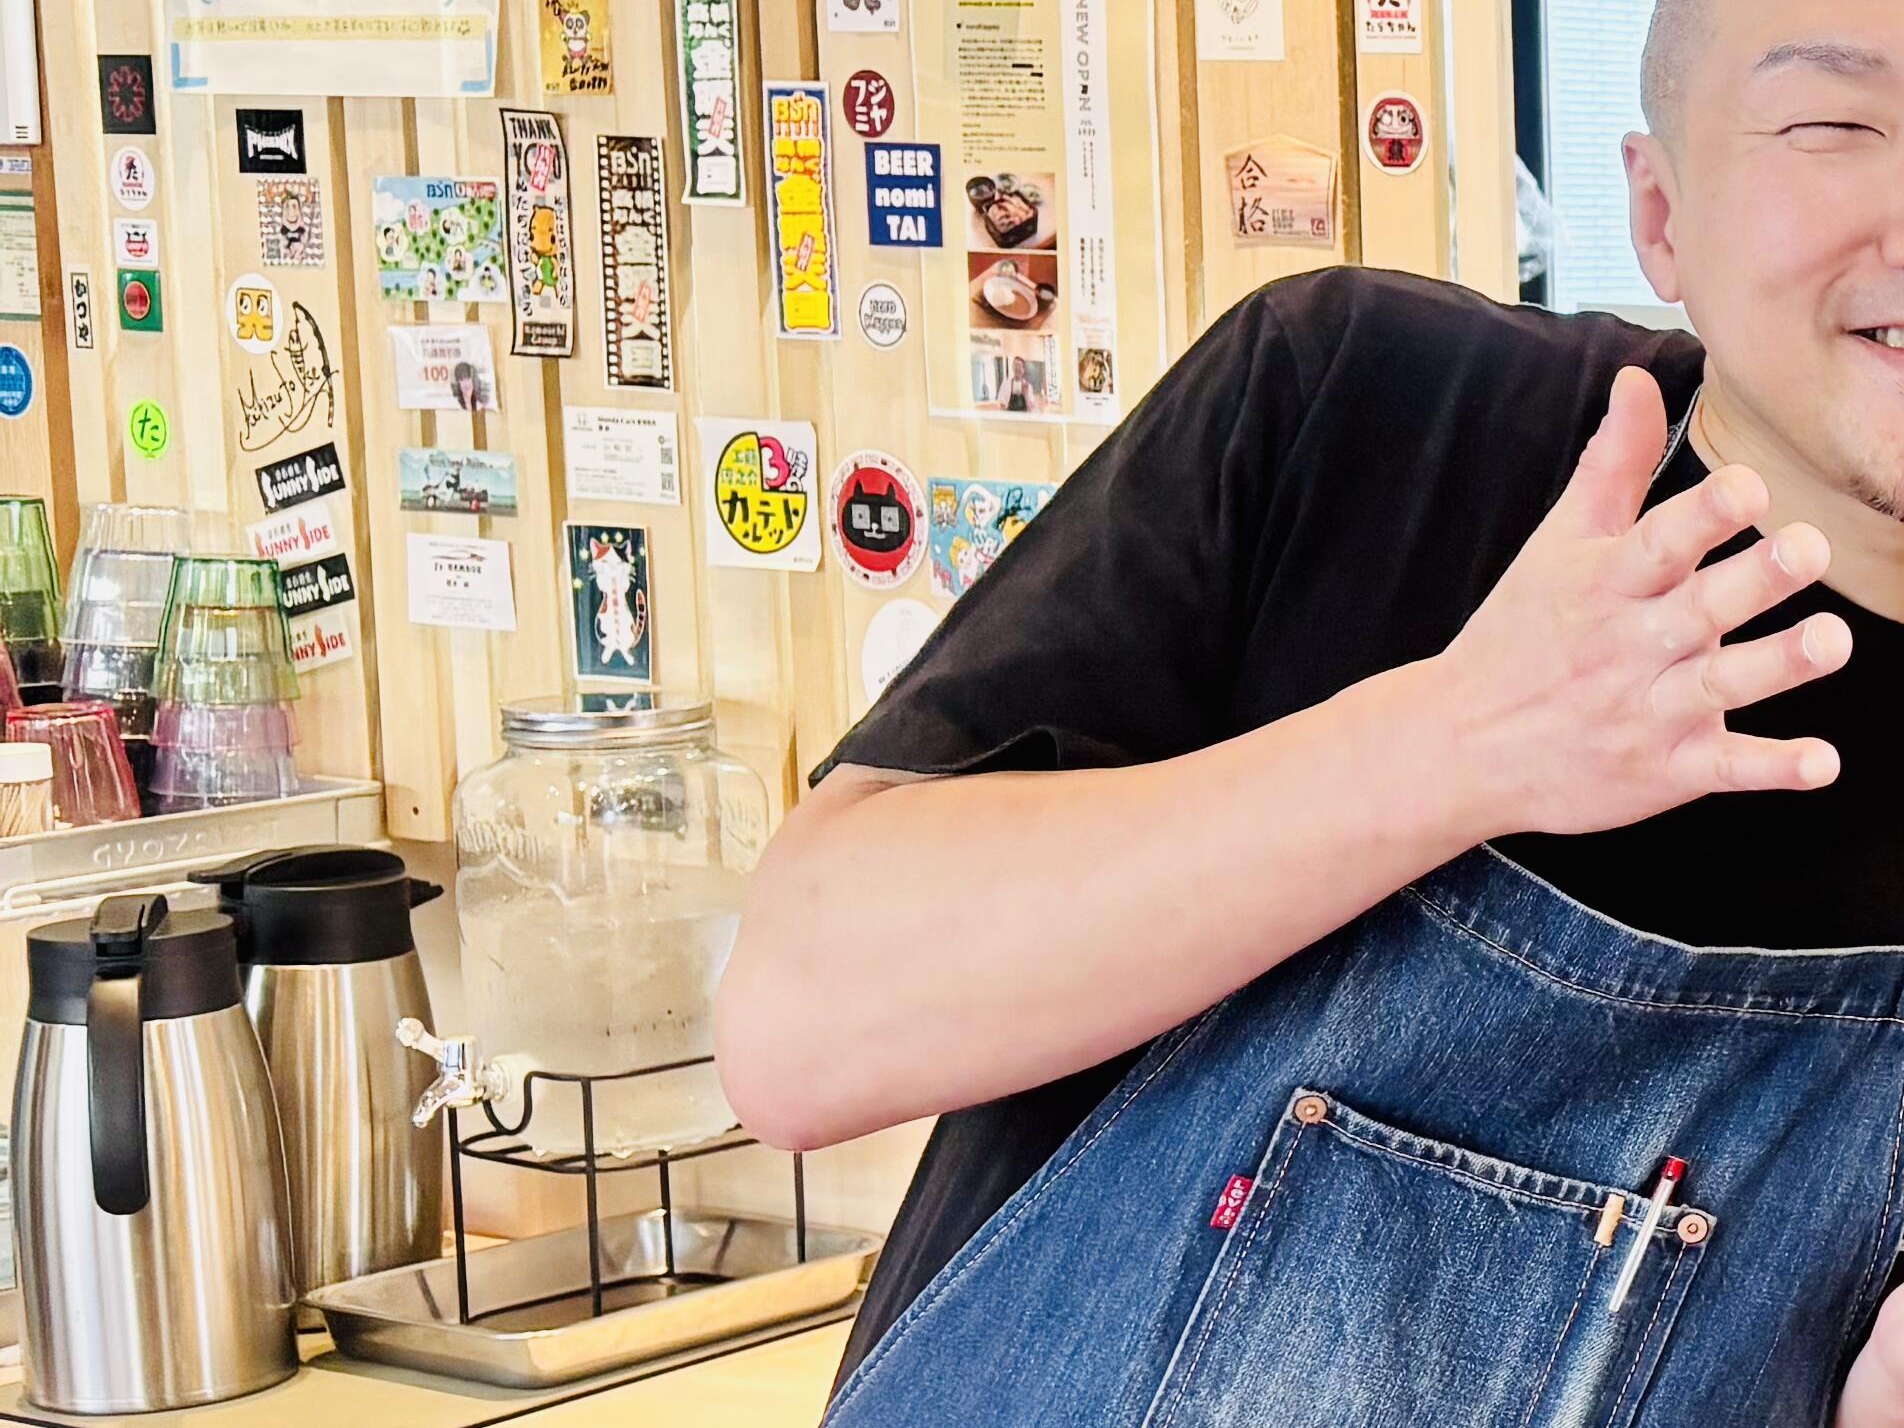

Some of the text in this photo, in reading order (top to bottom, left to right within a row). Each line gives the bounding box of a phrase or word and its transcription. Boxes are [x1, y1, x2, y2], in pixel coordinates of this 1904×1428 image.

[850, 79, 886, 105] フジ
[510, 117, 556, 139] THANK
[855, 105, 888, 131] ミヤ
[611, 148, 650, 173] BSN
[873, 150, 934, 177] BEER
[427, 181, 453, 198] BSN
[875, 184, 935, 209] nomi
[1236, 153, 1267, 236] 合格
[887, 215, 926, 241] TAI
[137, 407, 162, 443] た
[762, 436, 790, 489] 3
[262, 456, 340, 506] SUNNY SIDE
[298, 517, 331, 552] SIDE
[317, 564, 350, 602] SIDE
[315, 623, 347, 659] SIDE
